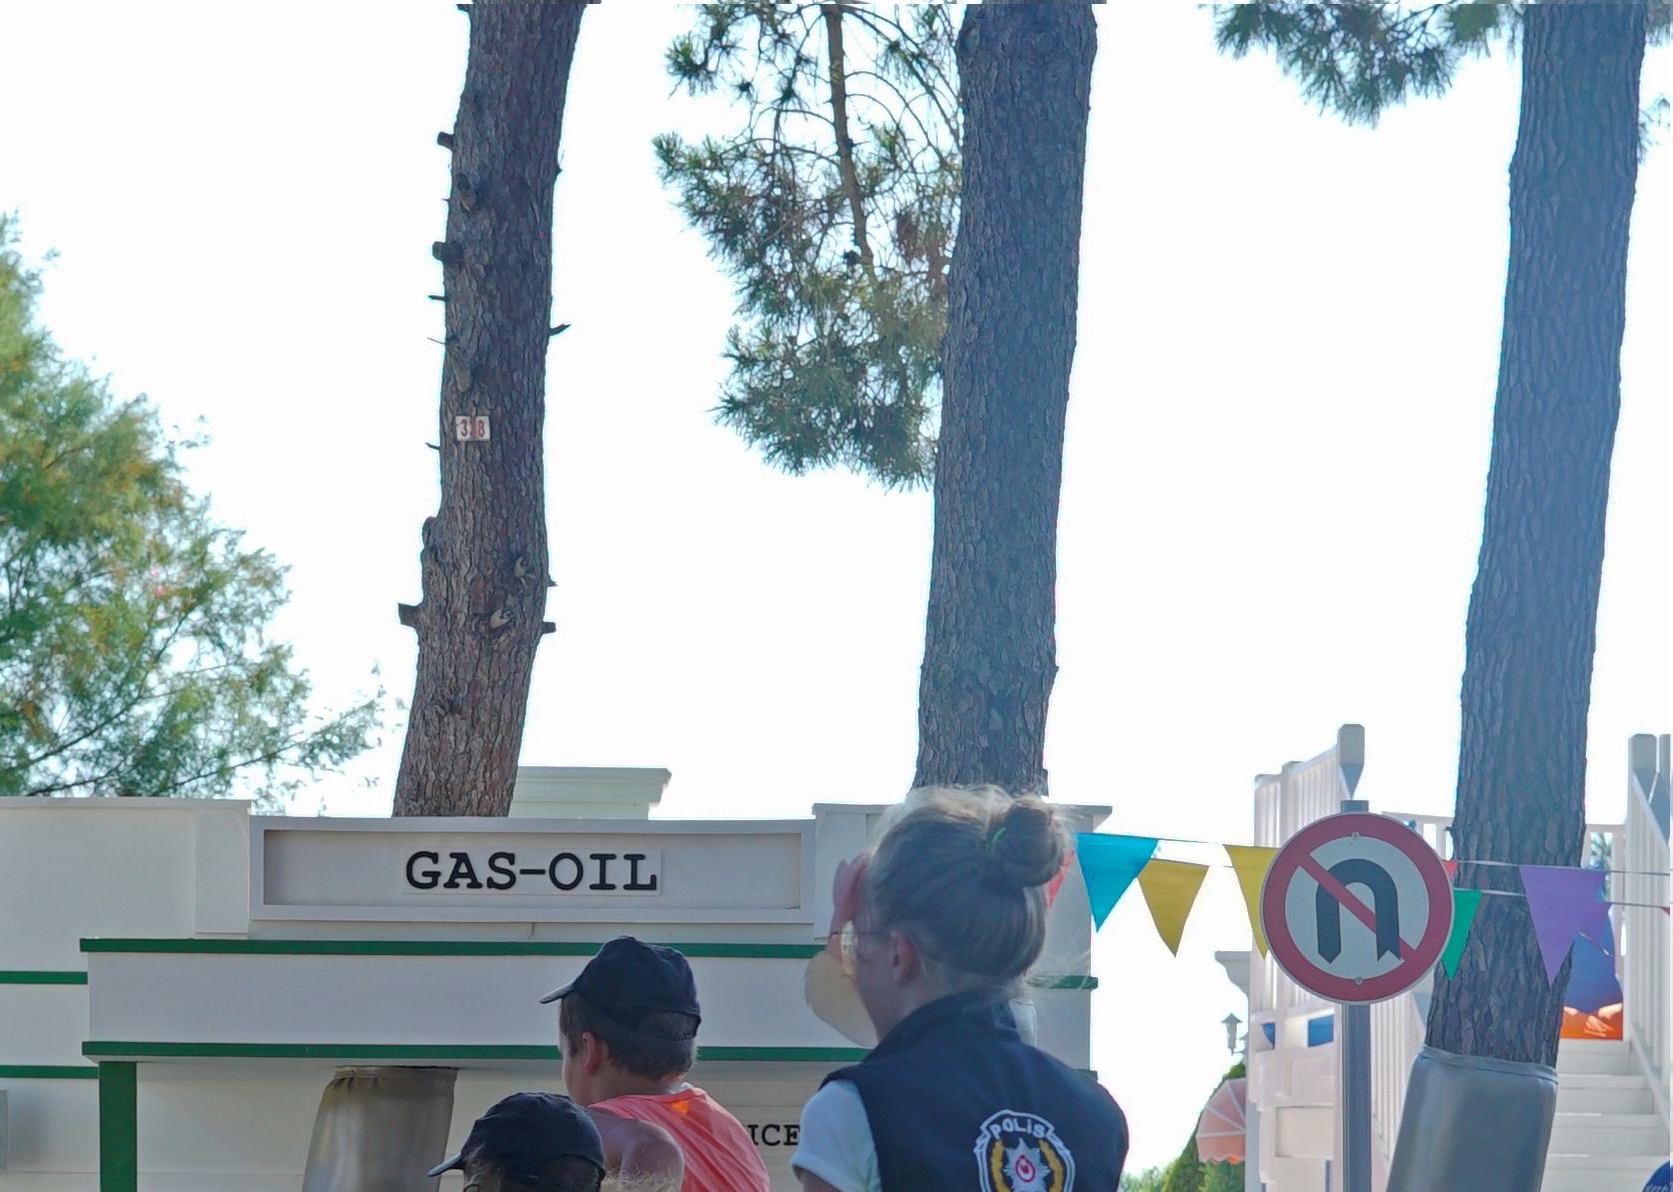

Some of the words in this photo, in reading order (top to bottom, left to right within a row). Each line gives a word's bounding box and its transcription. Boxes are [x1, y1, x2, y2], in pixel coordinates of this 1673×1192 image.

[406, 850, 657, 891] GAS-OIL
[747, 1124, 800, 1146] ICE
[989, 1117, 1045, 1139] POLIS
